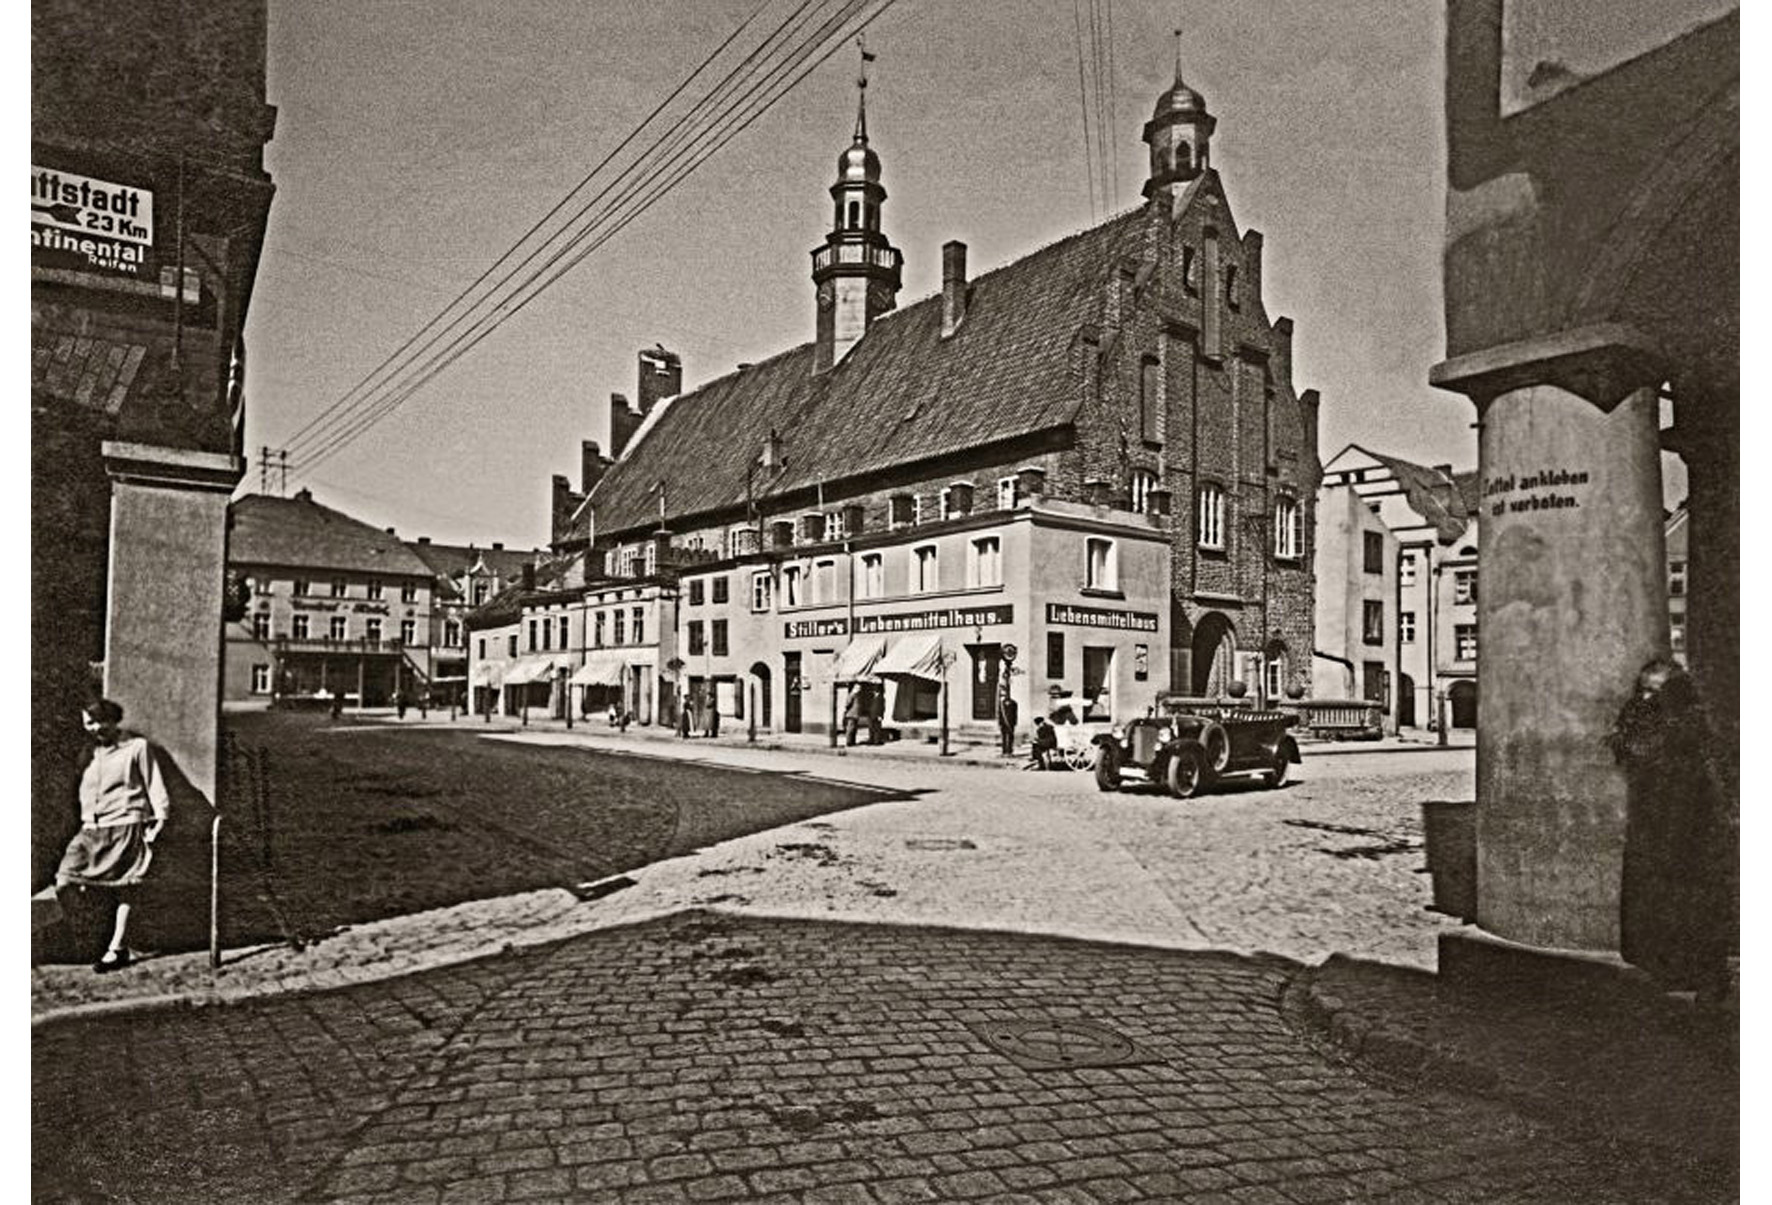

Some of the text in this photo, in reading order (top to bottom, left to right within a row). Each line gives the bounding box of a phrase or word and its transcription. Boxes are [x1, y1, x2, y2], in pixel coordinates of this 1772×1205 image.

[86, 211, 148, 239] 23 Km
[88, 253, 137, 272] Reifen
[1519, 469, 1589, 491] ankleben
[1510, 492, 1580, 512] verboten.
[1051, 605, 1156, 630] Lebensmittelhaus
[789, 621, 844, 637] Stiller's
